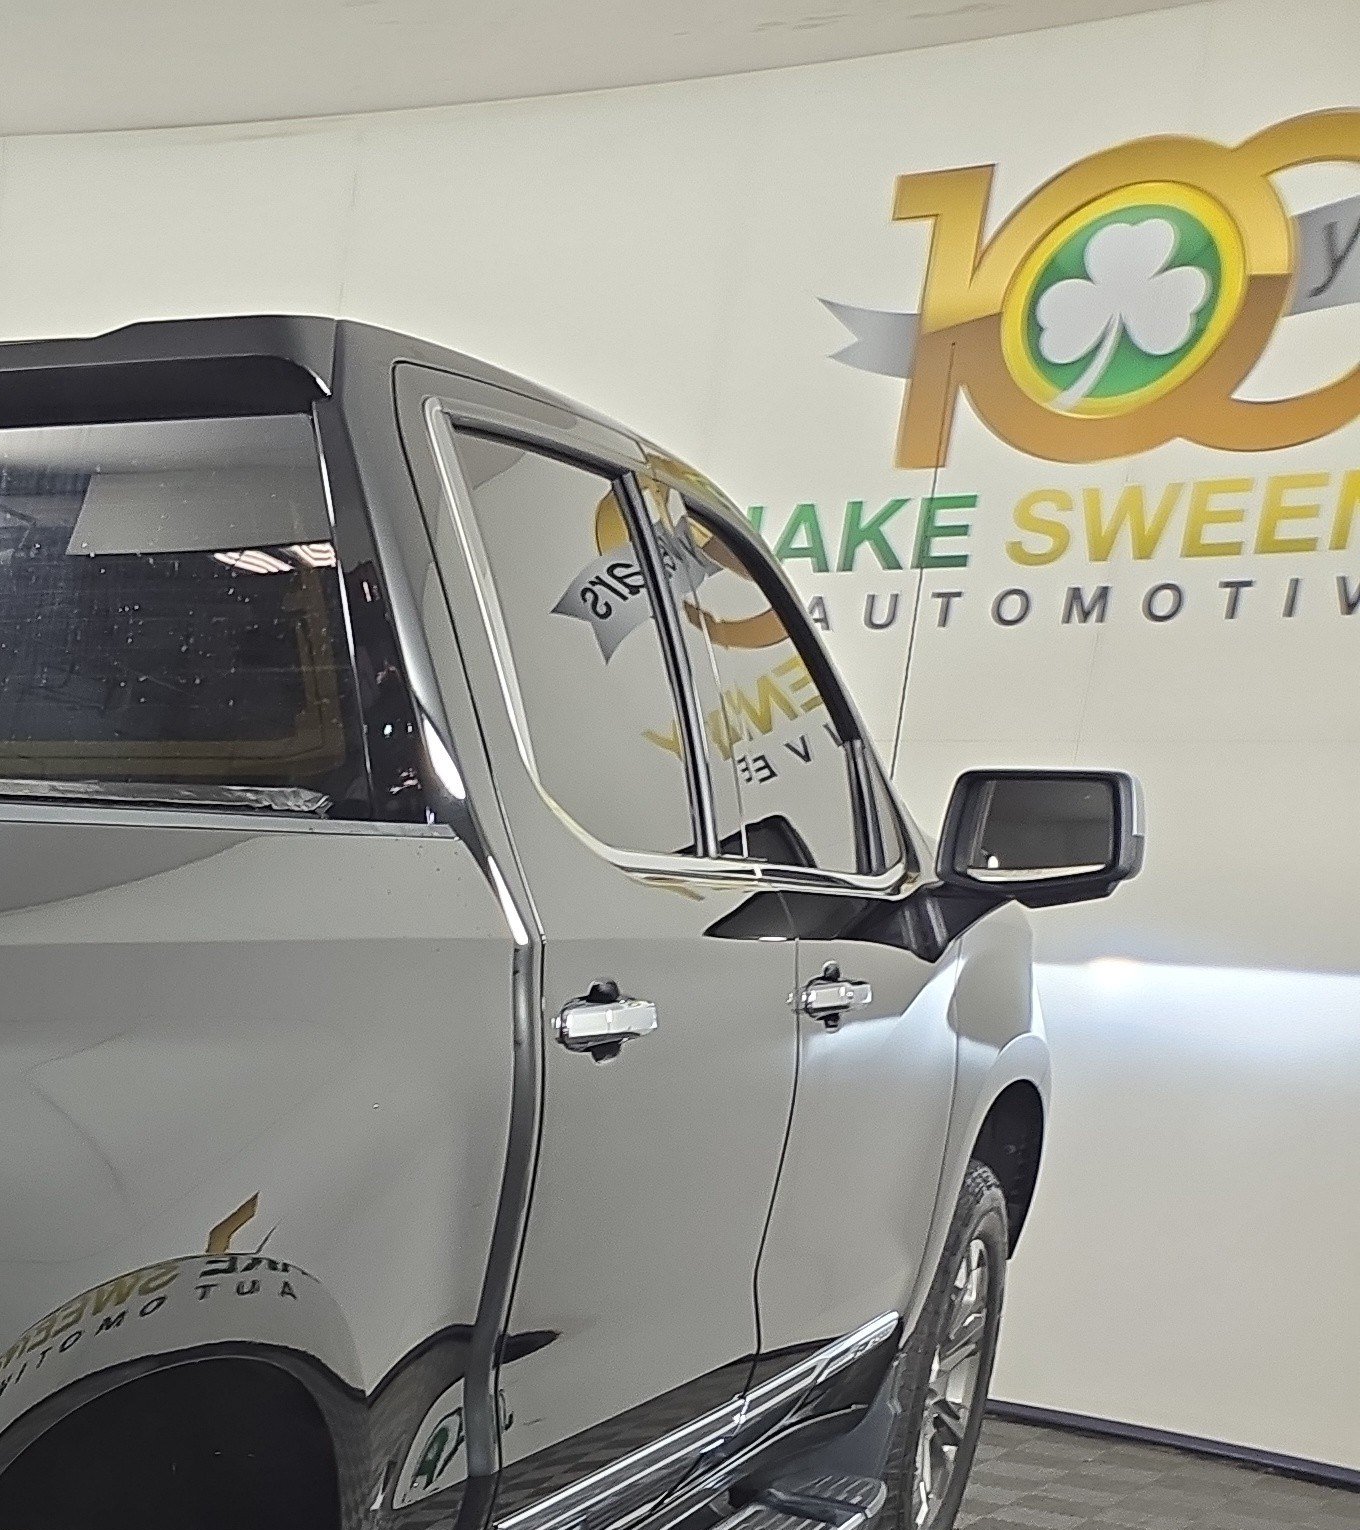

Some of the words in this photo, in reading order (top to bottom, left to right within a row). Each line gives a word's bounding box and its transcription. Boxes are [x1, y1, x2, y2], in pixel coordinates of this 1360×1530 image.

[747, 494, 978, 574] AKE
[1005, 470, 1360, 568] SWEE
[808, 574, 1360, 631] AUTOMOTIV
